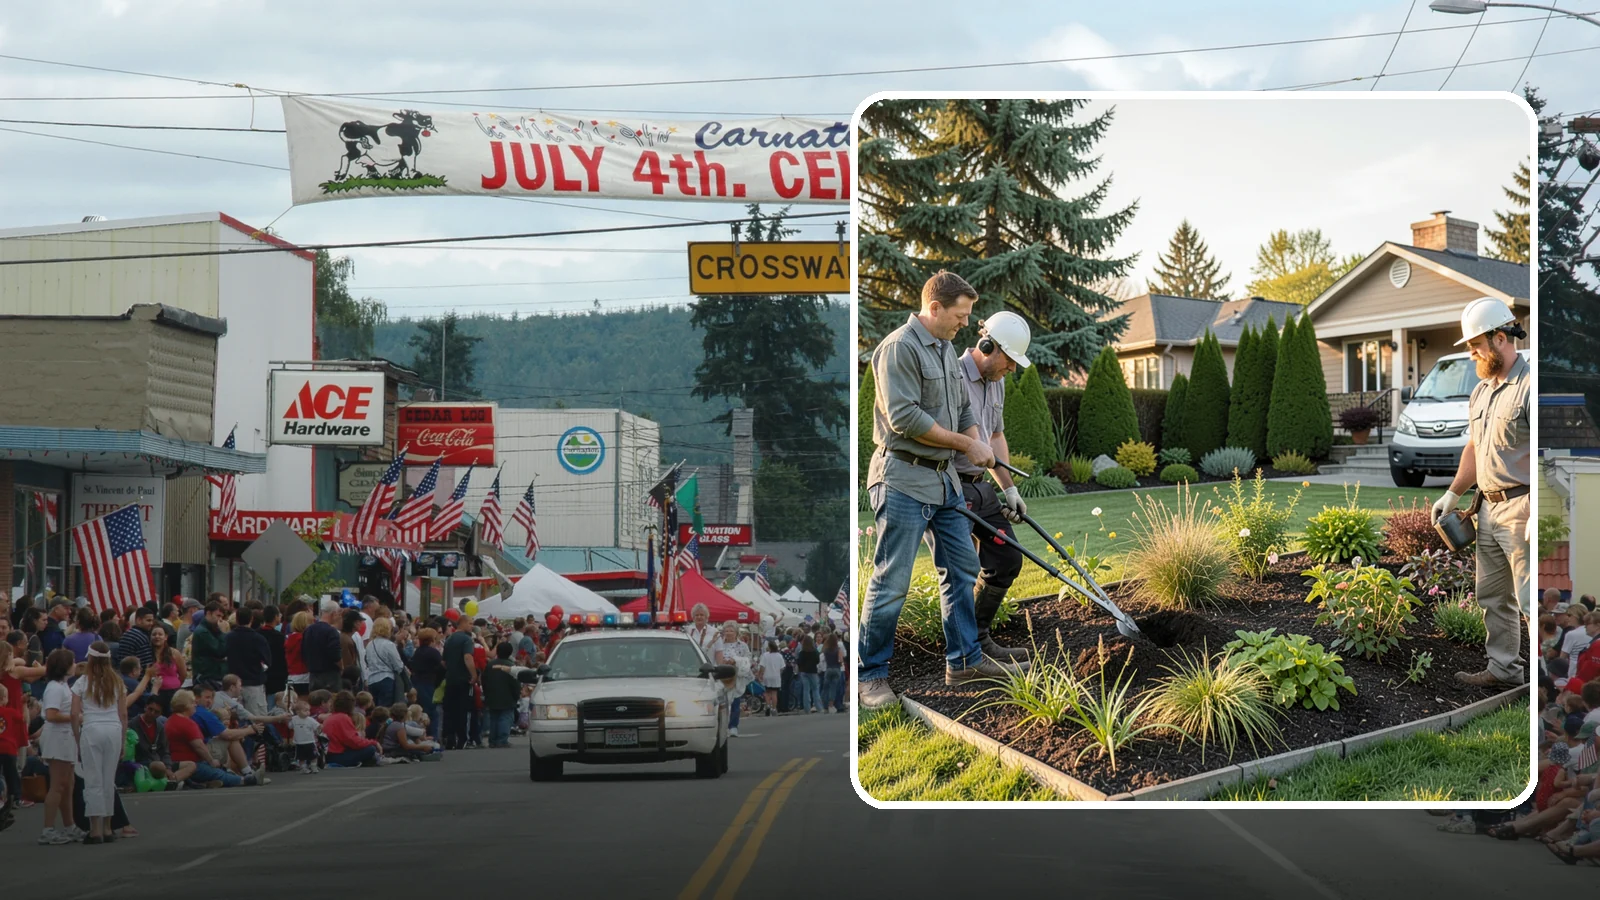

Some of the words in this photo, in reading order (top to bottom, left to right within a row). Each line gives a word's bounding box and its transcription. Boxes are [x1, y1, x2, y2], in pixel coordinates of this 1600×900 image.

[481, 141, 604, 192] JULY
[633, 150, 746, 197] 4th.
[697, 254, 850, 280] CROSSWA
[283, 380, 373, 420] ACE
[405, 410, 452, 422] CEDAR
[461, 410, 485, 422] LOG
[283, 421, 370, 436] Hardware
[96, 485, 124, 494] Vincent
[126, 486, 135, 494] de
[138, 486, 155, 495] Paul
[688, 526, 741, 535] CRNATION
[699, 535, 730, 543] GLASS
